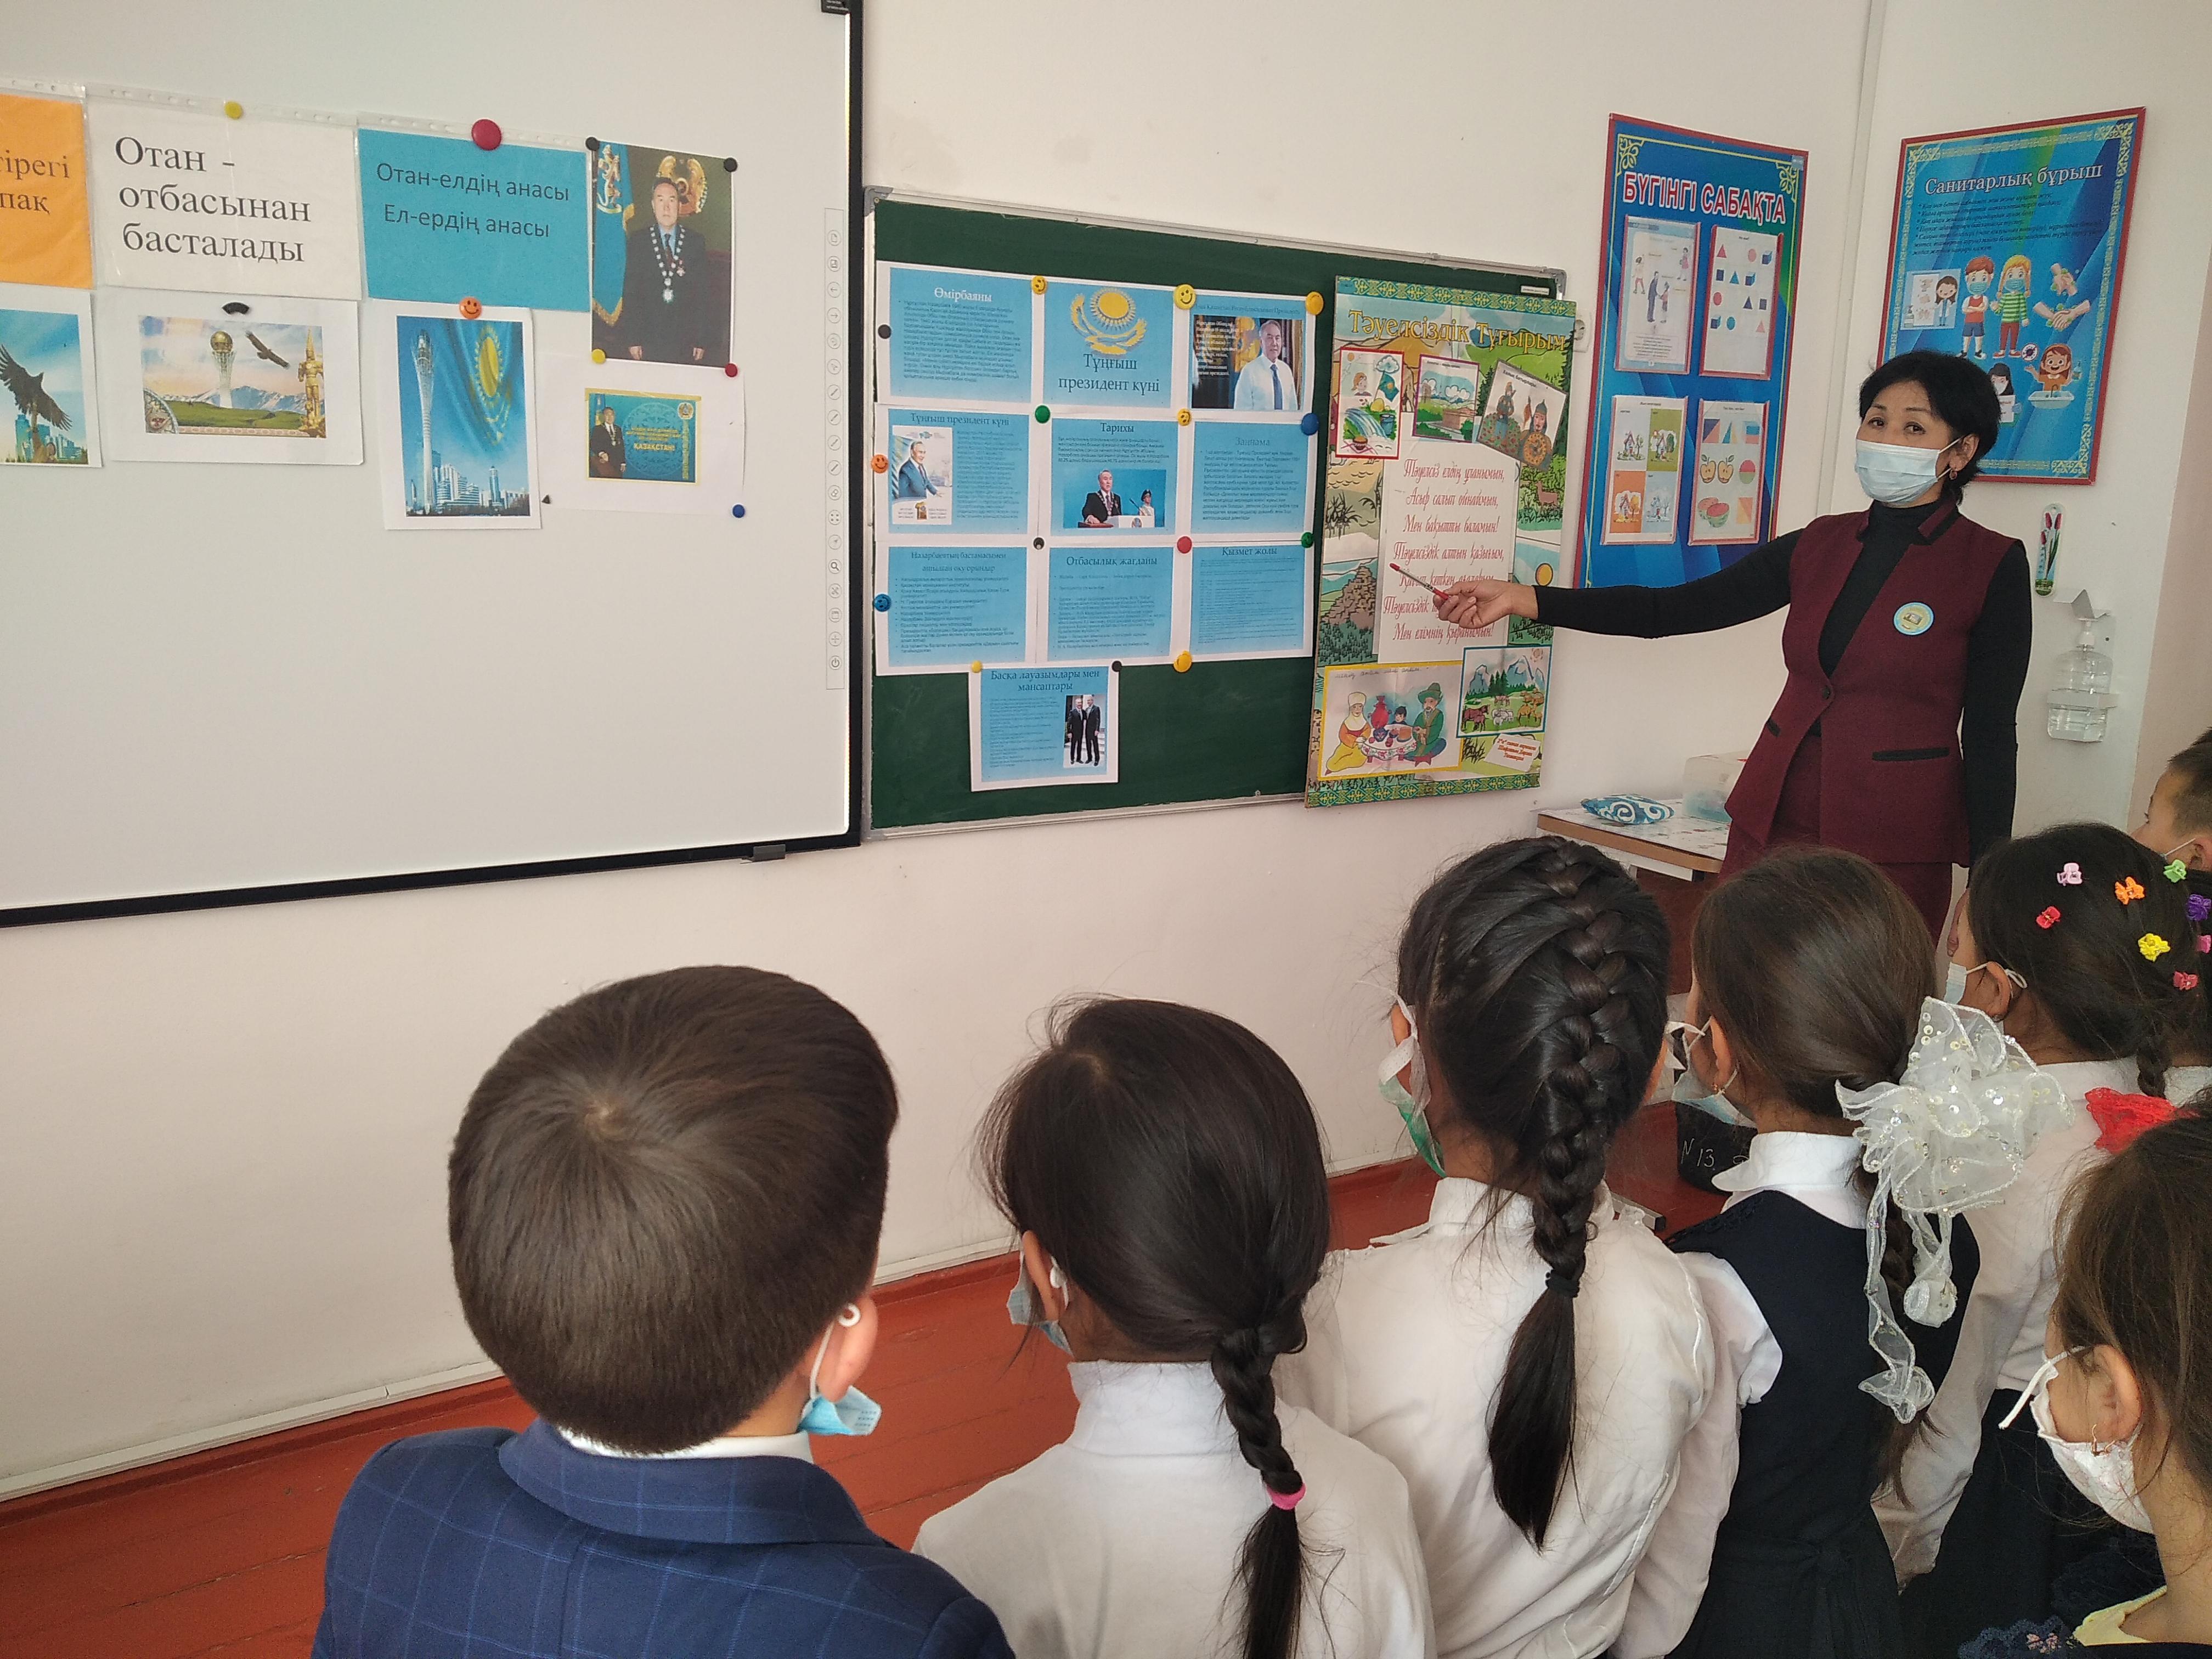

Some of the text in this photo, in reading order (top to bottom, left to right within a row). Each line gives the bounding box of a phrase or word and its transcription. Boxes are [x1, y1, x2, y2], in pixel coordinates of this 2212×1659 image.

[115, 137, 207, 172] Отан
[376, 163, 569, 201] Отан-елдің анасы
[1925, 164, 2103, 194] Санитарлық бұрыш
[119, 184, 311, 222] отбасынан
[1623, 171, 1786, 226] БҮГІНГІ САБАҚТА
[385, 204, 549, 238] Ел-ердің анасы
[123, 223, 305, 264] басталады
[934, 287, 992, 303] Өмірбаяны
[1348, 309, 1567, 354] Тәуелсіздік Тұғырым
[1058, 377, 1160, 397] президент күні
[1101, 422, 1135, 435] Тарихы
[1402, 514, 1423, 533] Мен
[1066, 556, 1118, 566] Отбасылық
[1255, 547, 1278, 555] жолы
[1393, 541, 1439, 566] Тәуелсіздік
[1383, 596, 1430, 619] Тәуелсіздік
[1392, 623, 1413, 641] Мен
[1697, 1148, 1714, 1167] 13
